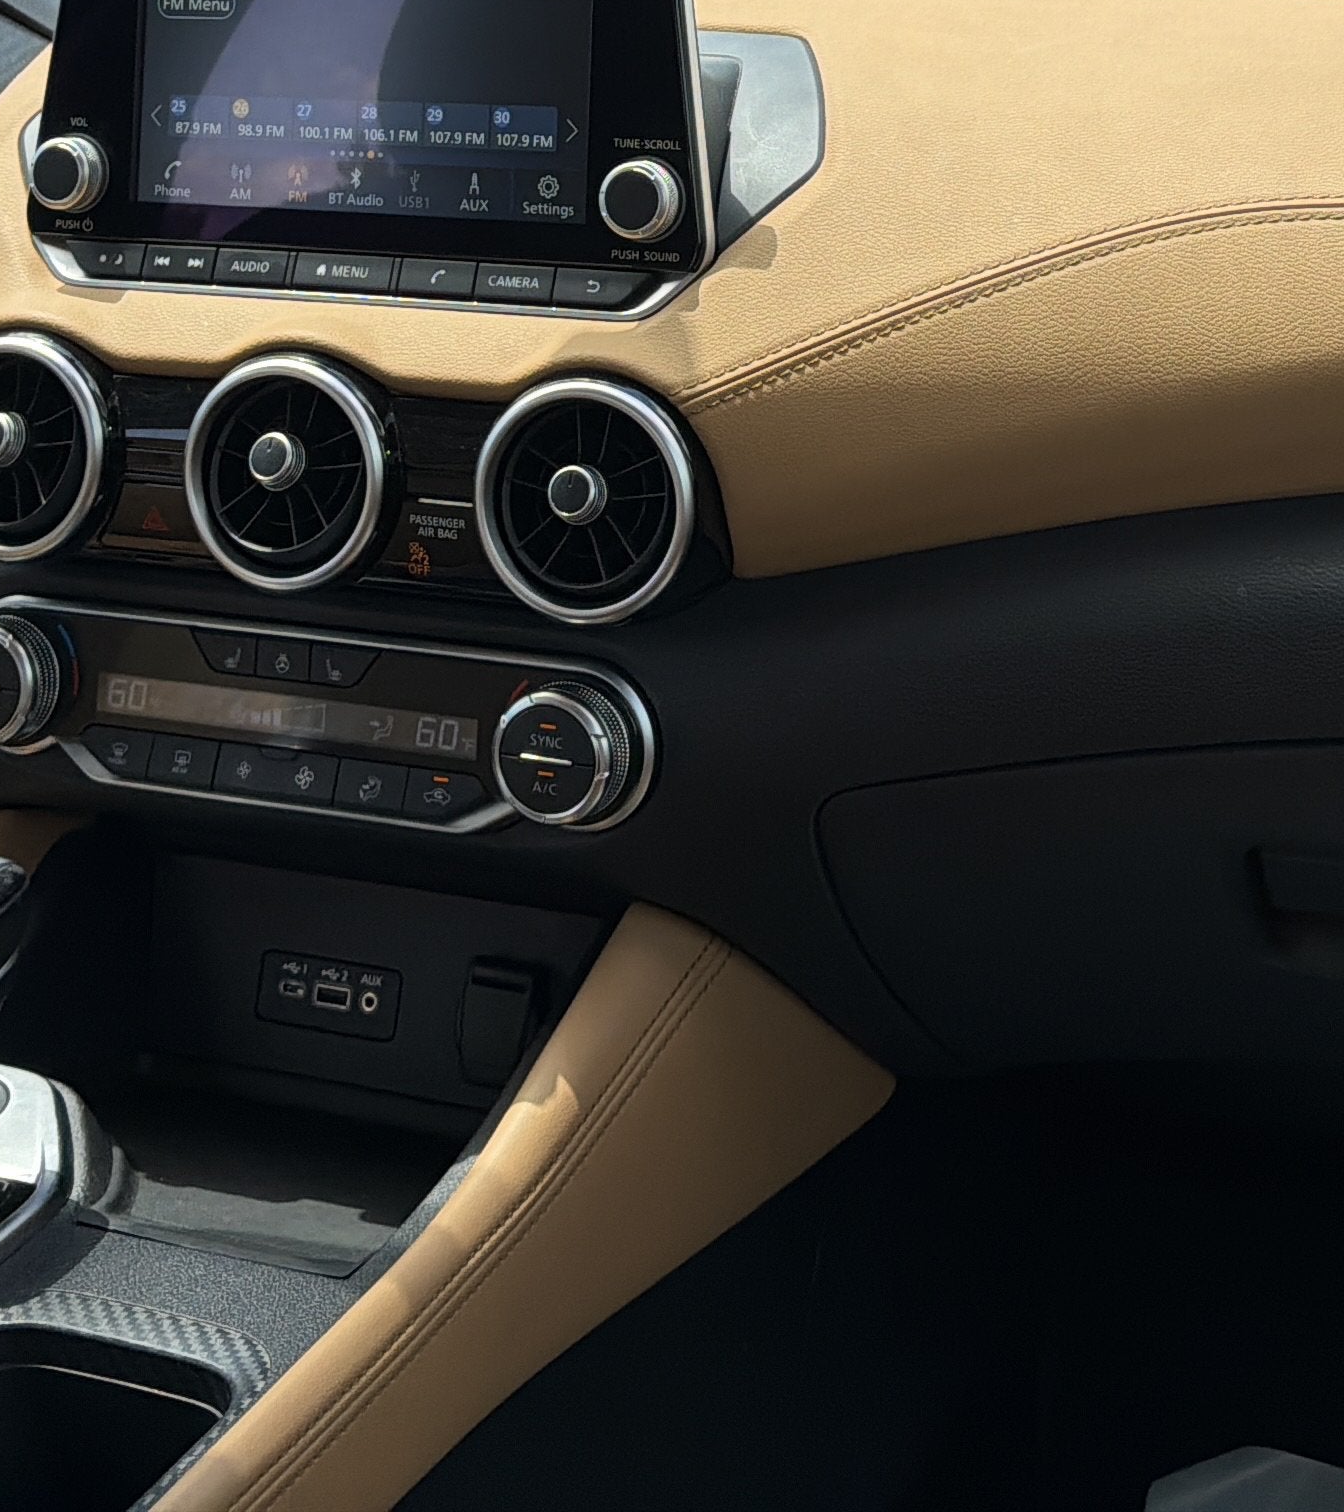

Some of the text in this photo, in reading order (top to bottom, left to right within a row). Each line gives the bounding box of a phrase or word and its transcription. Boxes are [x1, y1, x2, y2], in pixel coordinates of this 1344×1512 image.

[171, 99, 187, 113] 25
[297, 104, 312, 117] 27
[361, 106, 377, 120] 28
[70, 116, 89, 128] VOL
[427, 109, 443, 122] 29
[494, 111, 510, 124] 30
[175, 121, 222, 135] 87.9 FM
[238, 124, 285, 137] 98.9 FM
[299, 126, 353, 140] 100.1 FM
[363, 129, 418, 143] 106.1 FM
[429, 131, 485, 145] 107.9 FM
[496, 133, 553, 148] 107.9 FM
[154, 184, 191, 198] Phone
[229, 188, 251, 200] AM
[288, 190, 308, 203] FM
[328, 192, 384, 207] BT Audio
[399, 195, 430, 209] USB1
[460, 198, 489, 212] AUX
[522, 201, 575, 220] Settings
[56, 218, 80, 230] PUSH
[611, 248, 681, 263] PUSH SOUND
[230, 260, 270, 274] AUDIO
[331, 264, 369, 279] MENU
[488, 274, 540, 289] CAMERA
[409, 514, 466, 529] PASSENGER
[417, 526, 458, 540] AIR BAG
[408, 563, 431, 576] OFF
[529, 733, 563, 750] SYNC
[532, 781, 557, 796] A/C
[360, 973, 384, 987] AUX
